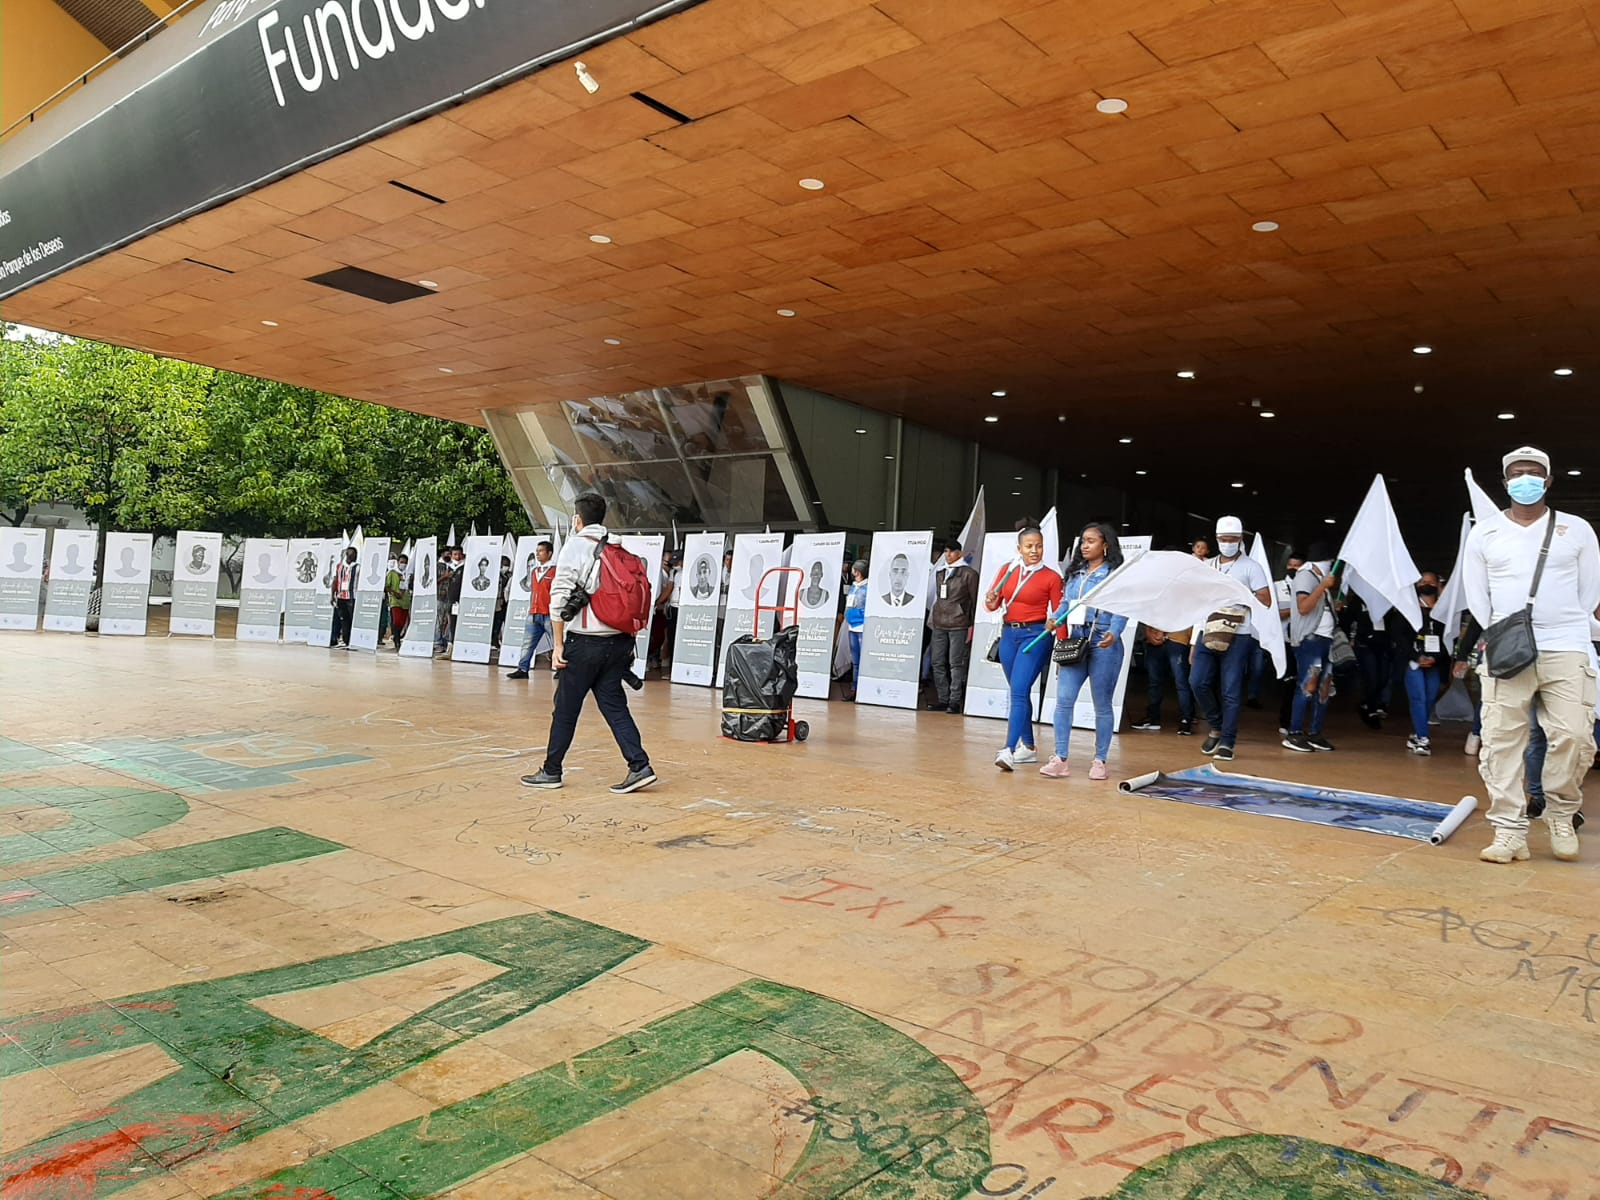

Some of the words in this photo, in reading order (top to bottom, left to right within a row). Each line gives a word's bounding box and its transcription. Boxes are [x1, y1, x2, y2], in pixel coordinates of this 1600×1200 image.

[2, 256, 25, 275] Parque
[23, 249, 33, 266] de
[29, 246, 42, 261] los
[38, 236, 64, 258] Deseos
